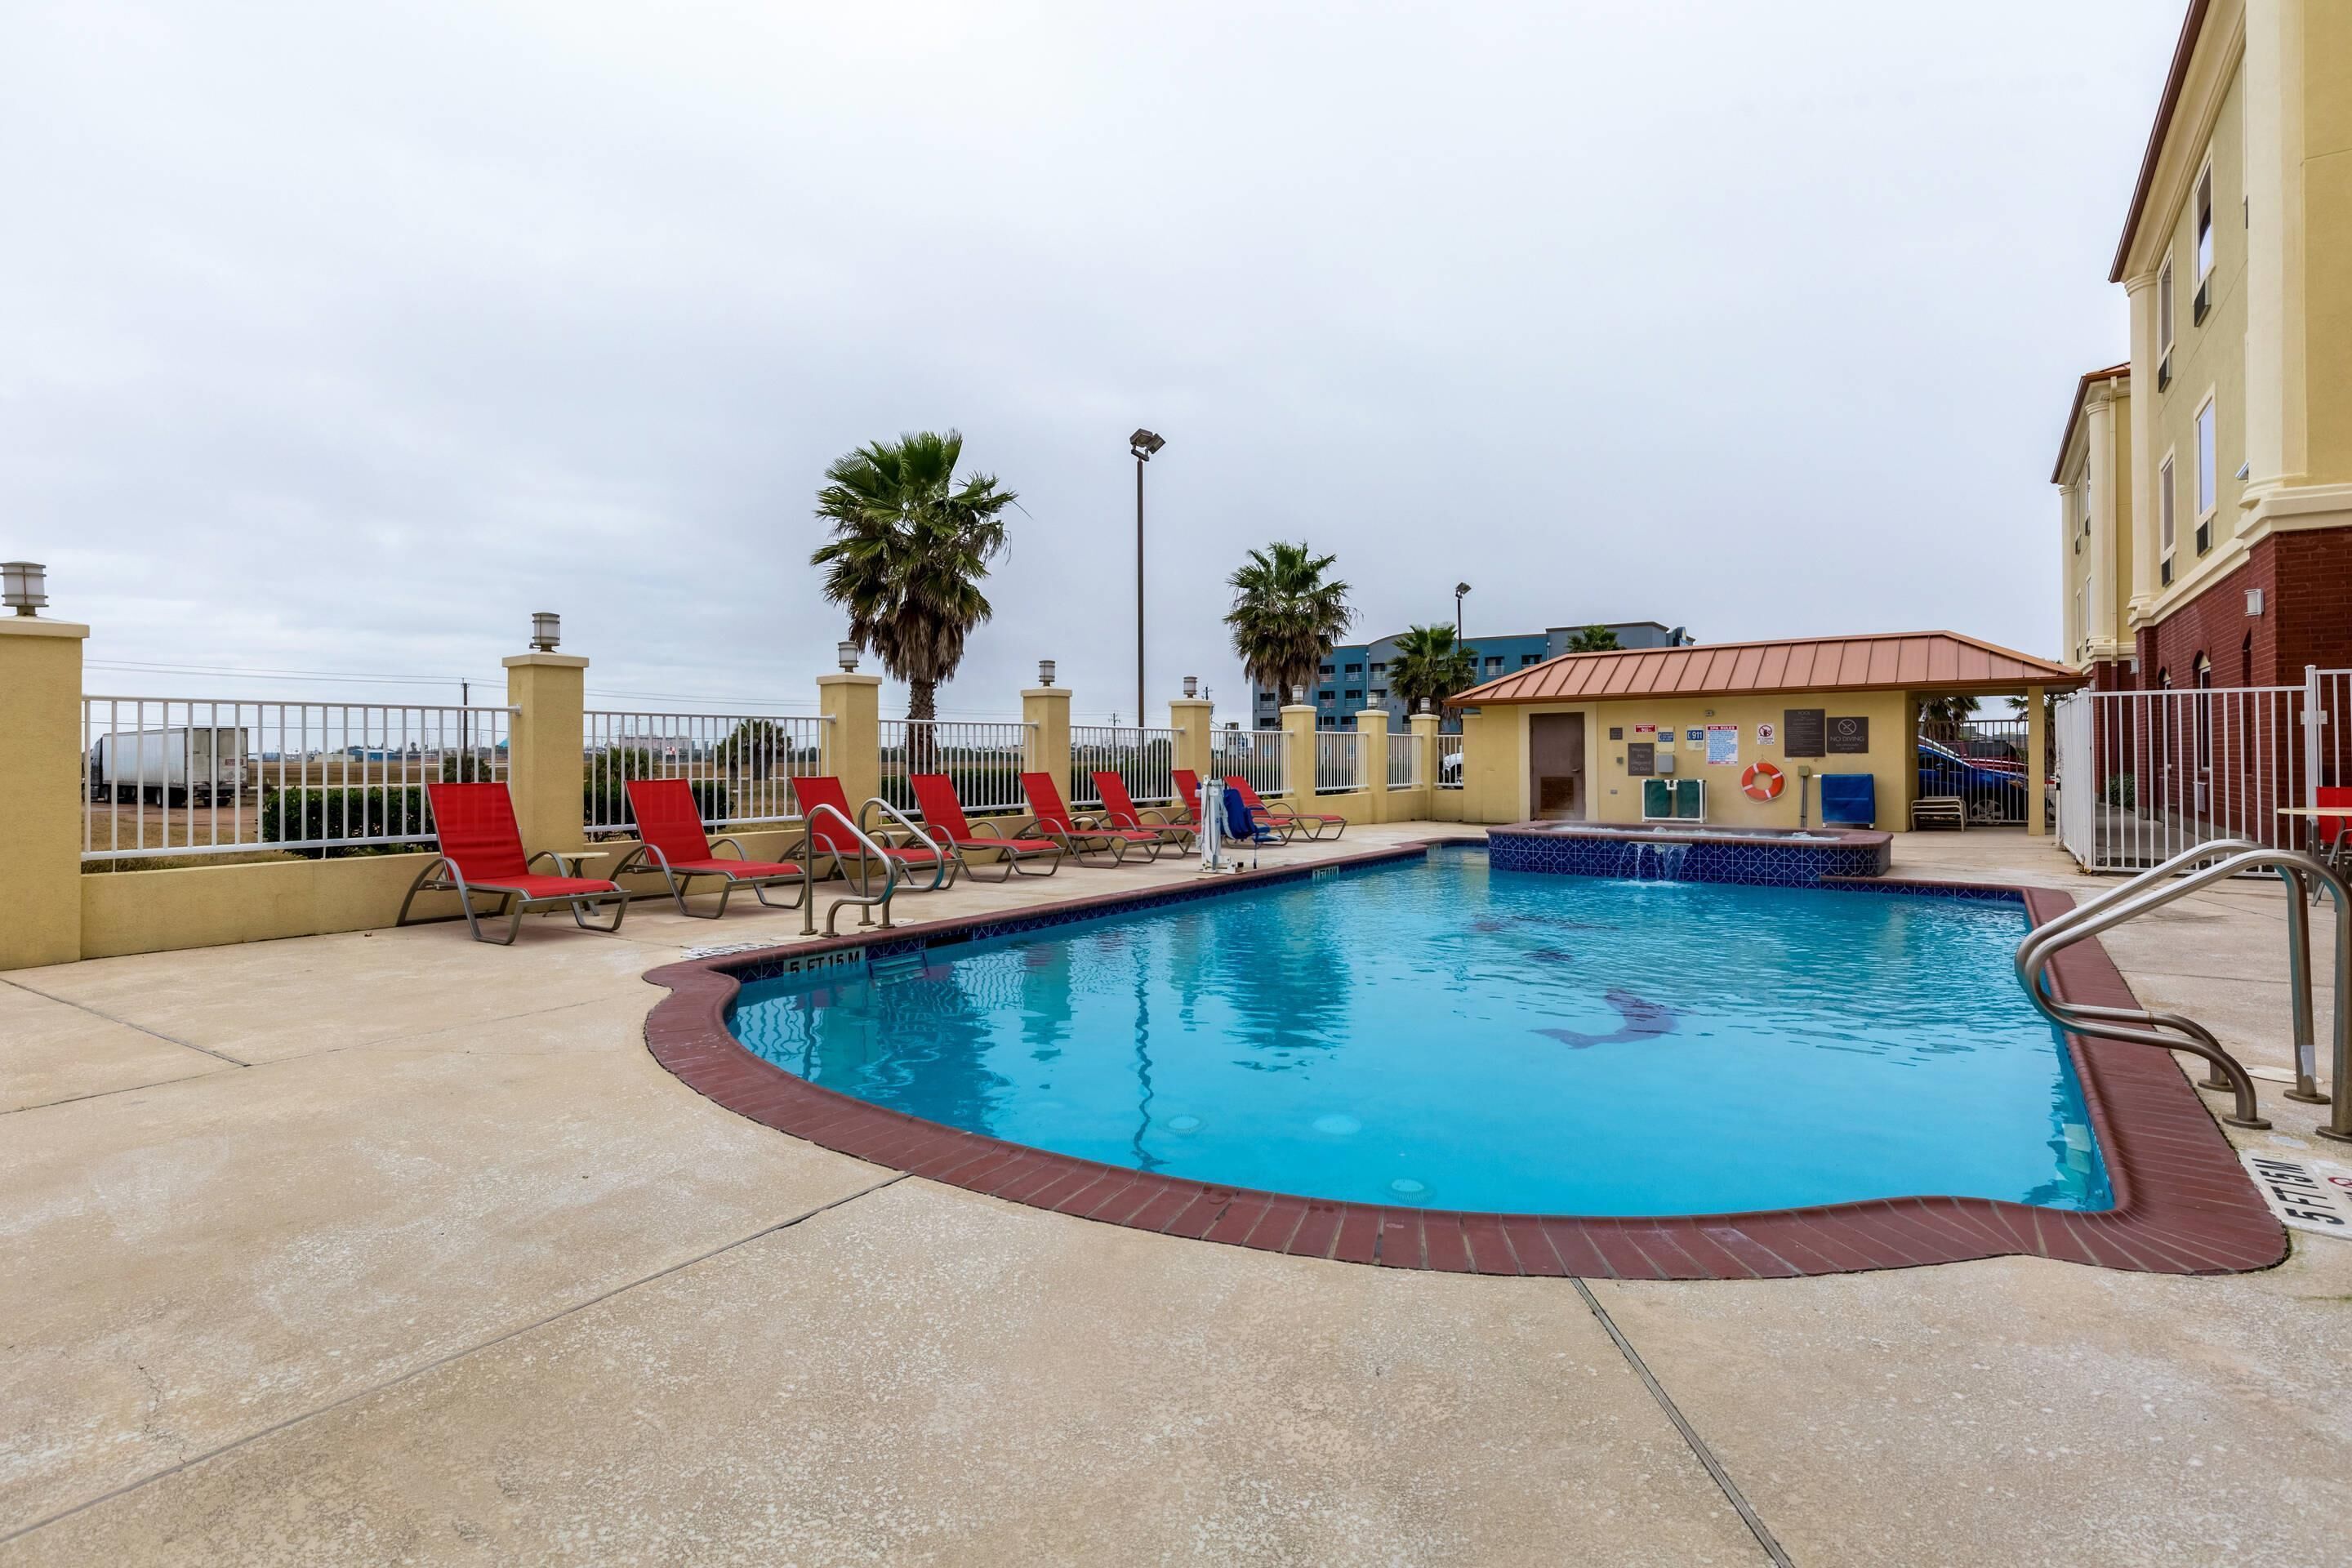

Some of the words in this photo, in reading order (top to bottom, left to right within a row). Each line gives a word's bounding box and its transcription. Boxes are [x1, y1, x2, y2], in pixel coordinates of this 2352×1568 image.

[1691, 731, 1703, 739] 911
[790, 961, 800, 973] 5
[807, 956, 825, 973] FT
[2270, 1186, 2336, 1210] FT
[2284, 1207, 2345, 1225] 5
